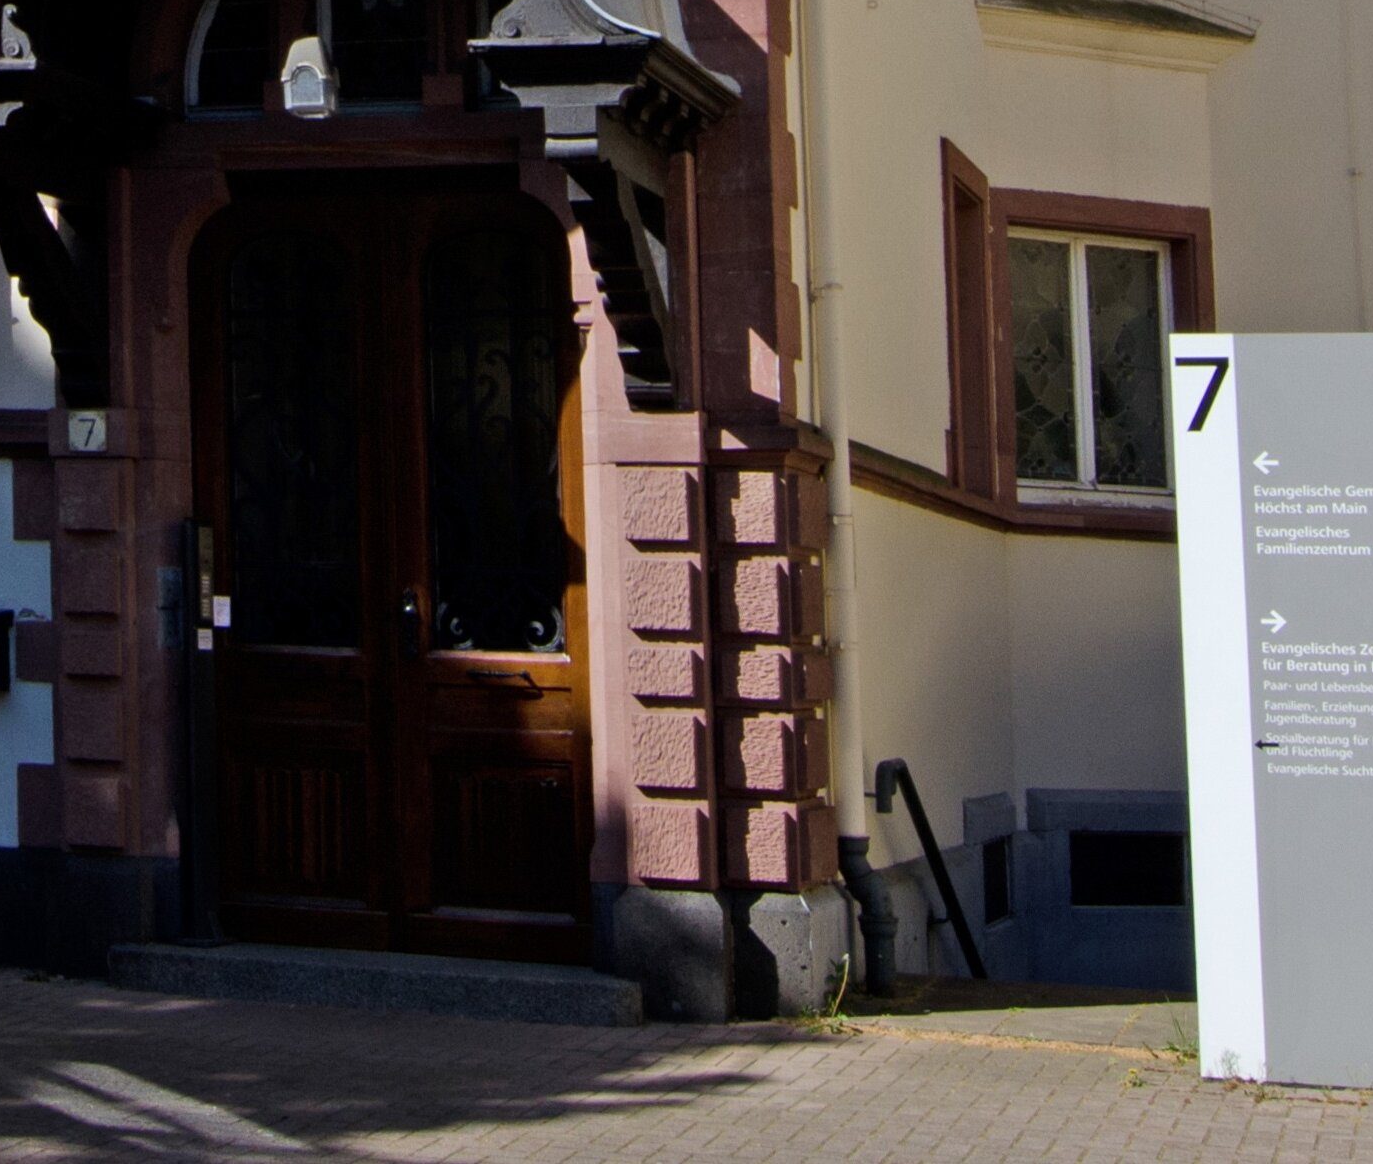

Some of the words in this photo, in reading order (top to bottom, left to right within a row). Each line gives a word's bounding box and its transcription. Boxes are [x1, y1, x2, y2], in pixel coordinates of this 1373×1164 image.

[1175, 356, 1230, 432] 7
[77, 418, 97, 448] 7
[1253, 484, 1342, 501] Evangelische
[1254, 501, 1303, 514] Höchst
[1305, 504, 1328, 514] am
[1331, 502, 1368, 514] Main
[1255, 525, 1351, 541] Evangelisches
[1256, 542, 1371, 556] Familienzentrum
[1261, 641, 1357, 658] Evangelisches
[1262, 657, 1283, 671] für
[1286, 659, 1350, 676] Beratung
[1353, 660, 1367, 673] in
[1262, 679, 1292, 691] Paar-
[1295, 681, 1318, 692] und
[1264, 712, 1357, 729] Jugendberatung
[1265, 732, 1350, 749] Sozialberatung
[1352, 734, 1369, 746] für
[1266, 745, 1289, 757] und
[1291, 744, 1354, 761] Flüchtlinge
[1267, 762, 1340, 777] Evangelische
